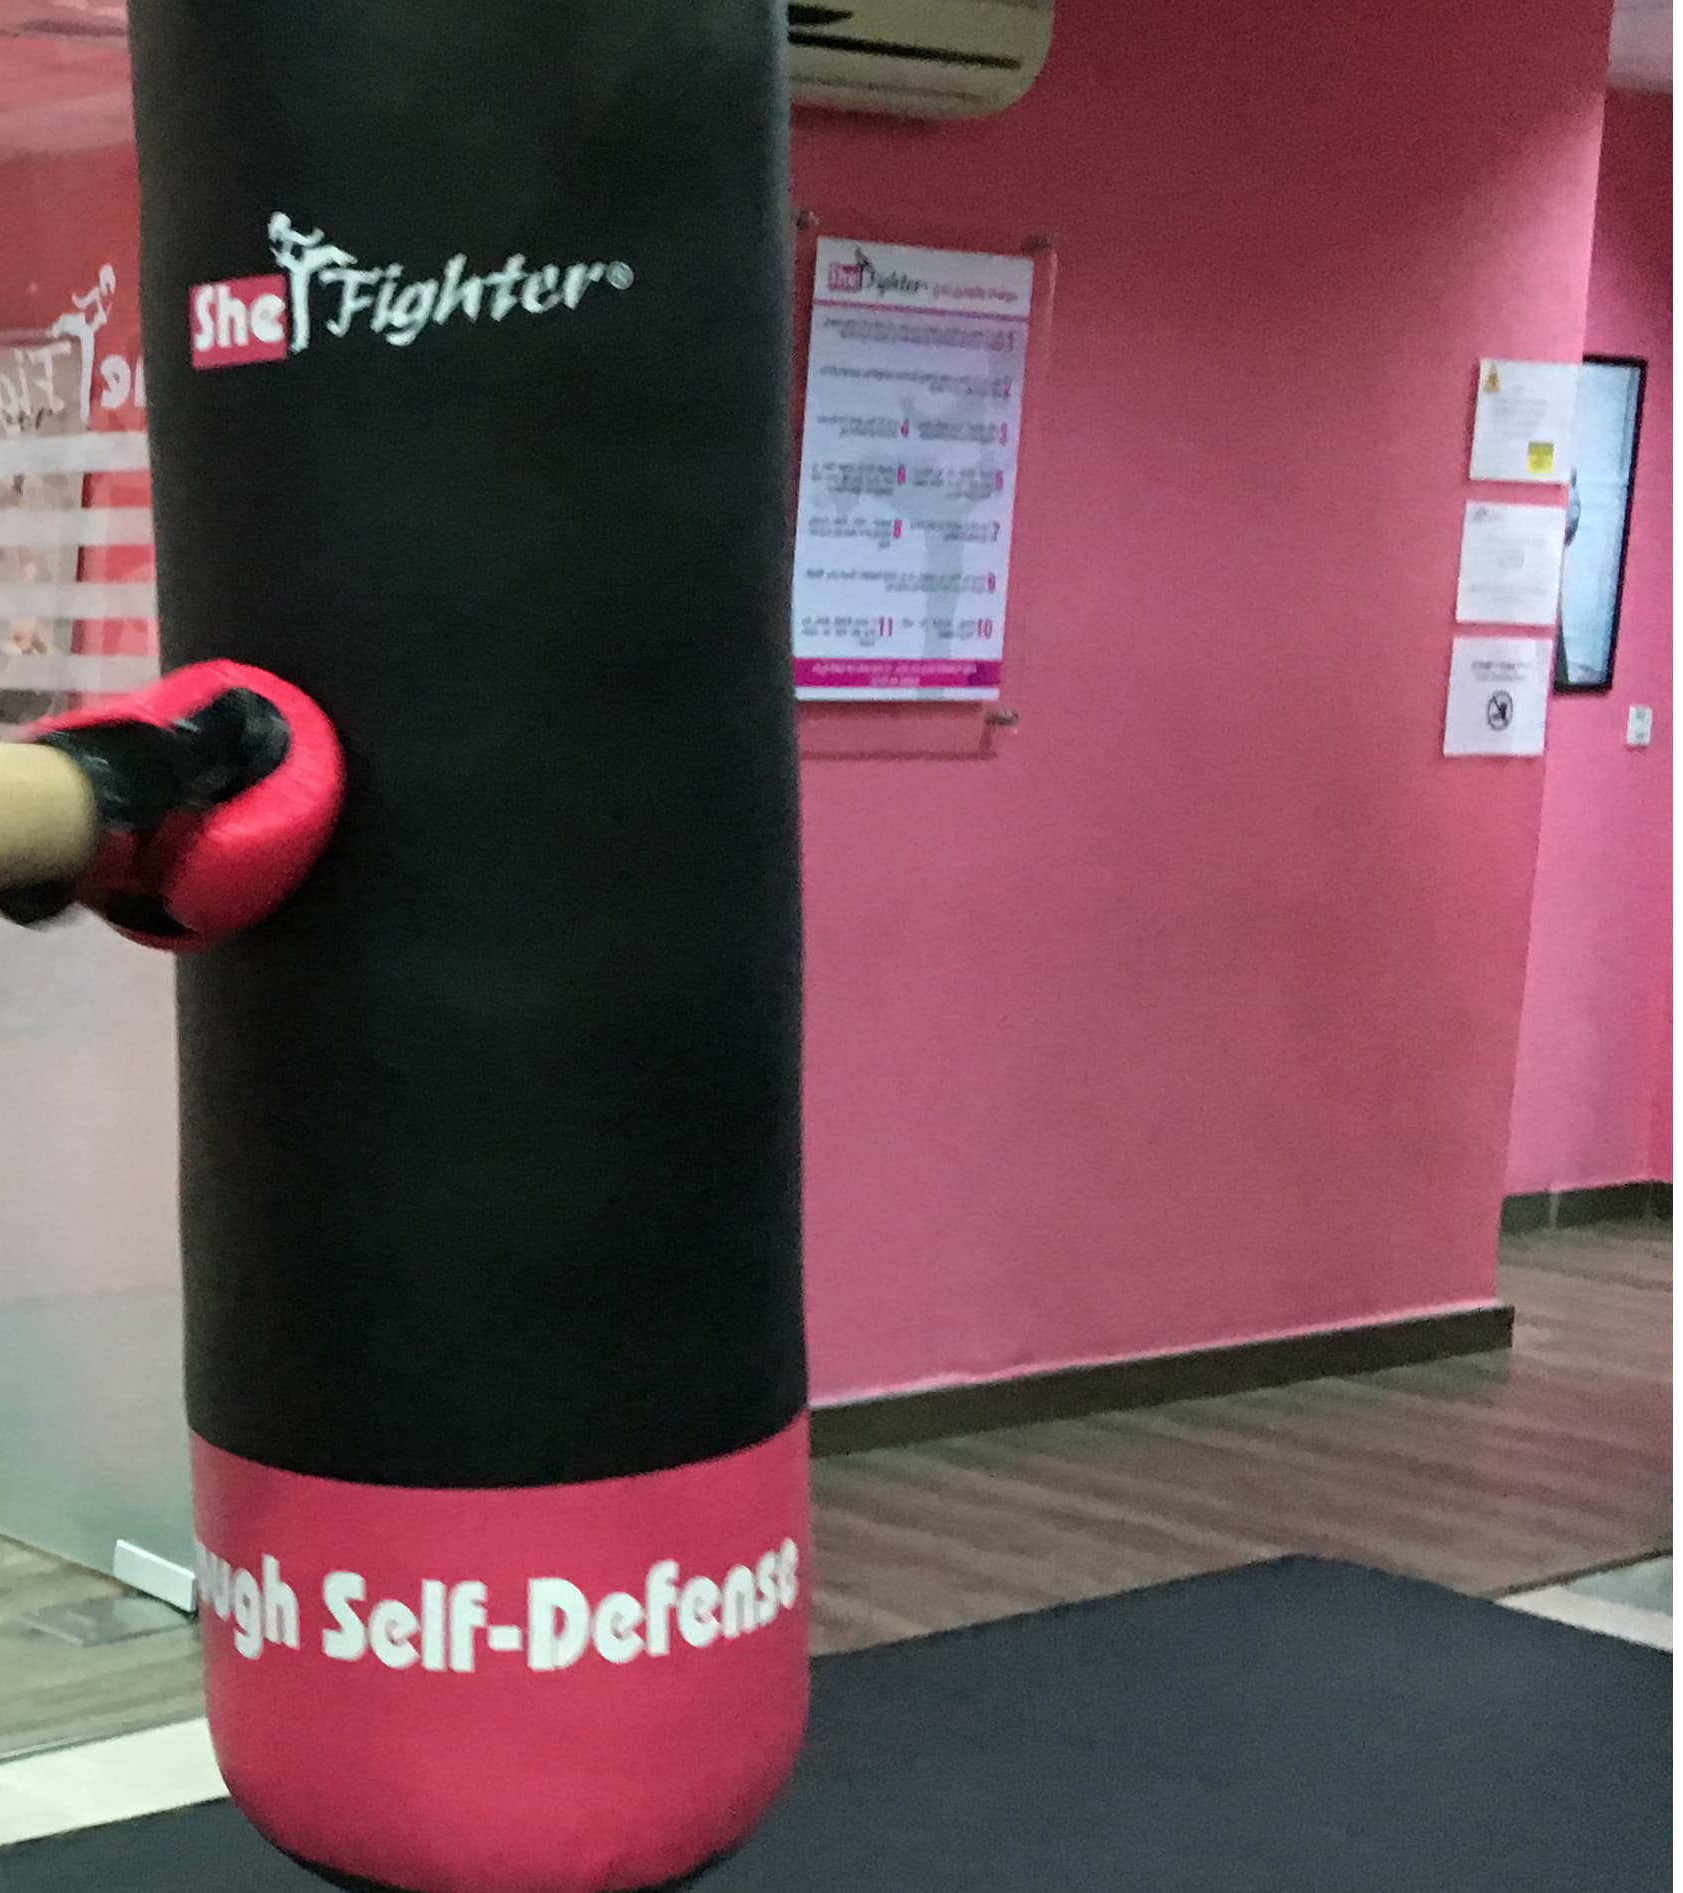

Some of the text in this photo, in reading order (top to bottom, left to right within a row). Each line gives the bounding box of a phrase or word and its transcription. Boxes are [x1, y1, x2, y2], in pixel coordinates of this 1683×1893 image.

[194, 253, 605, 353] She Fighter
[878, 616, 894, 638] 11
[977, 618, 993, 639] 10
[322, 1537, 799, 1673] Self-Defense
